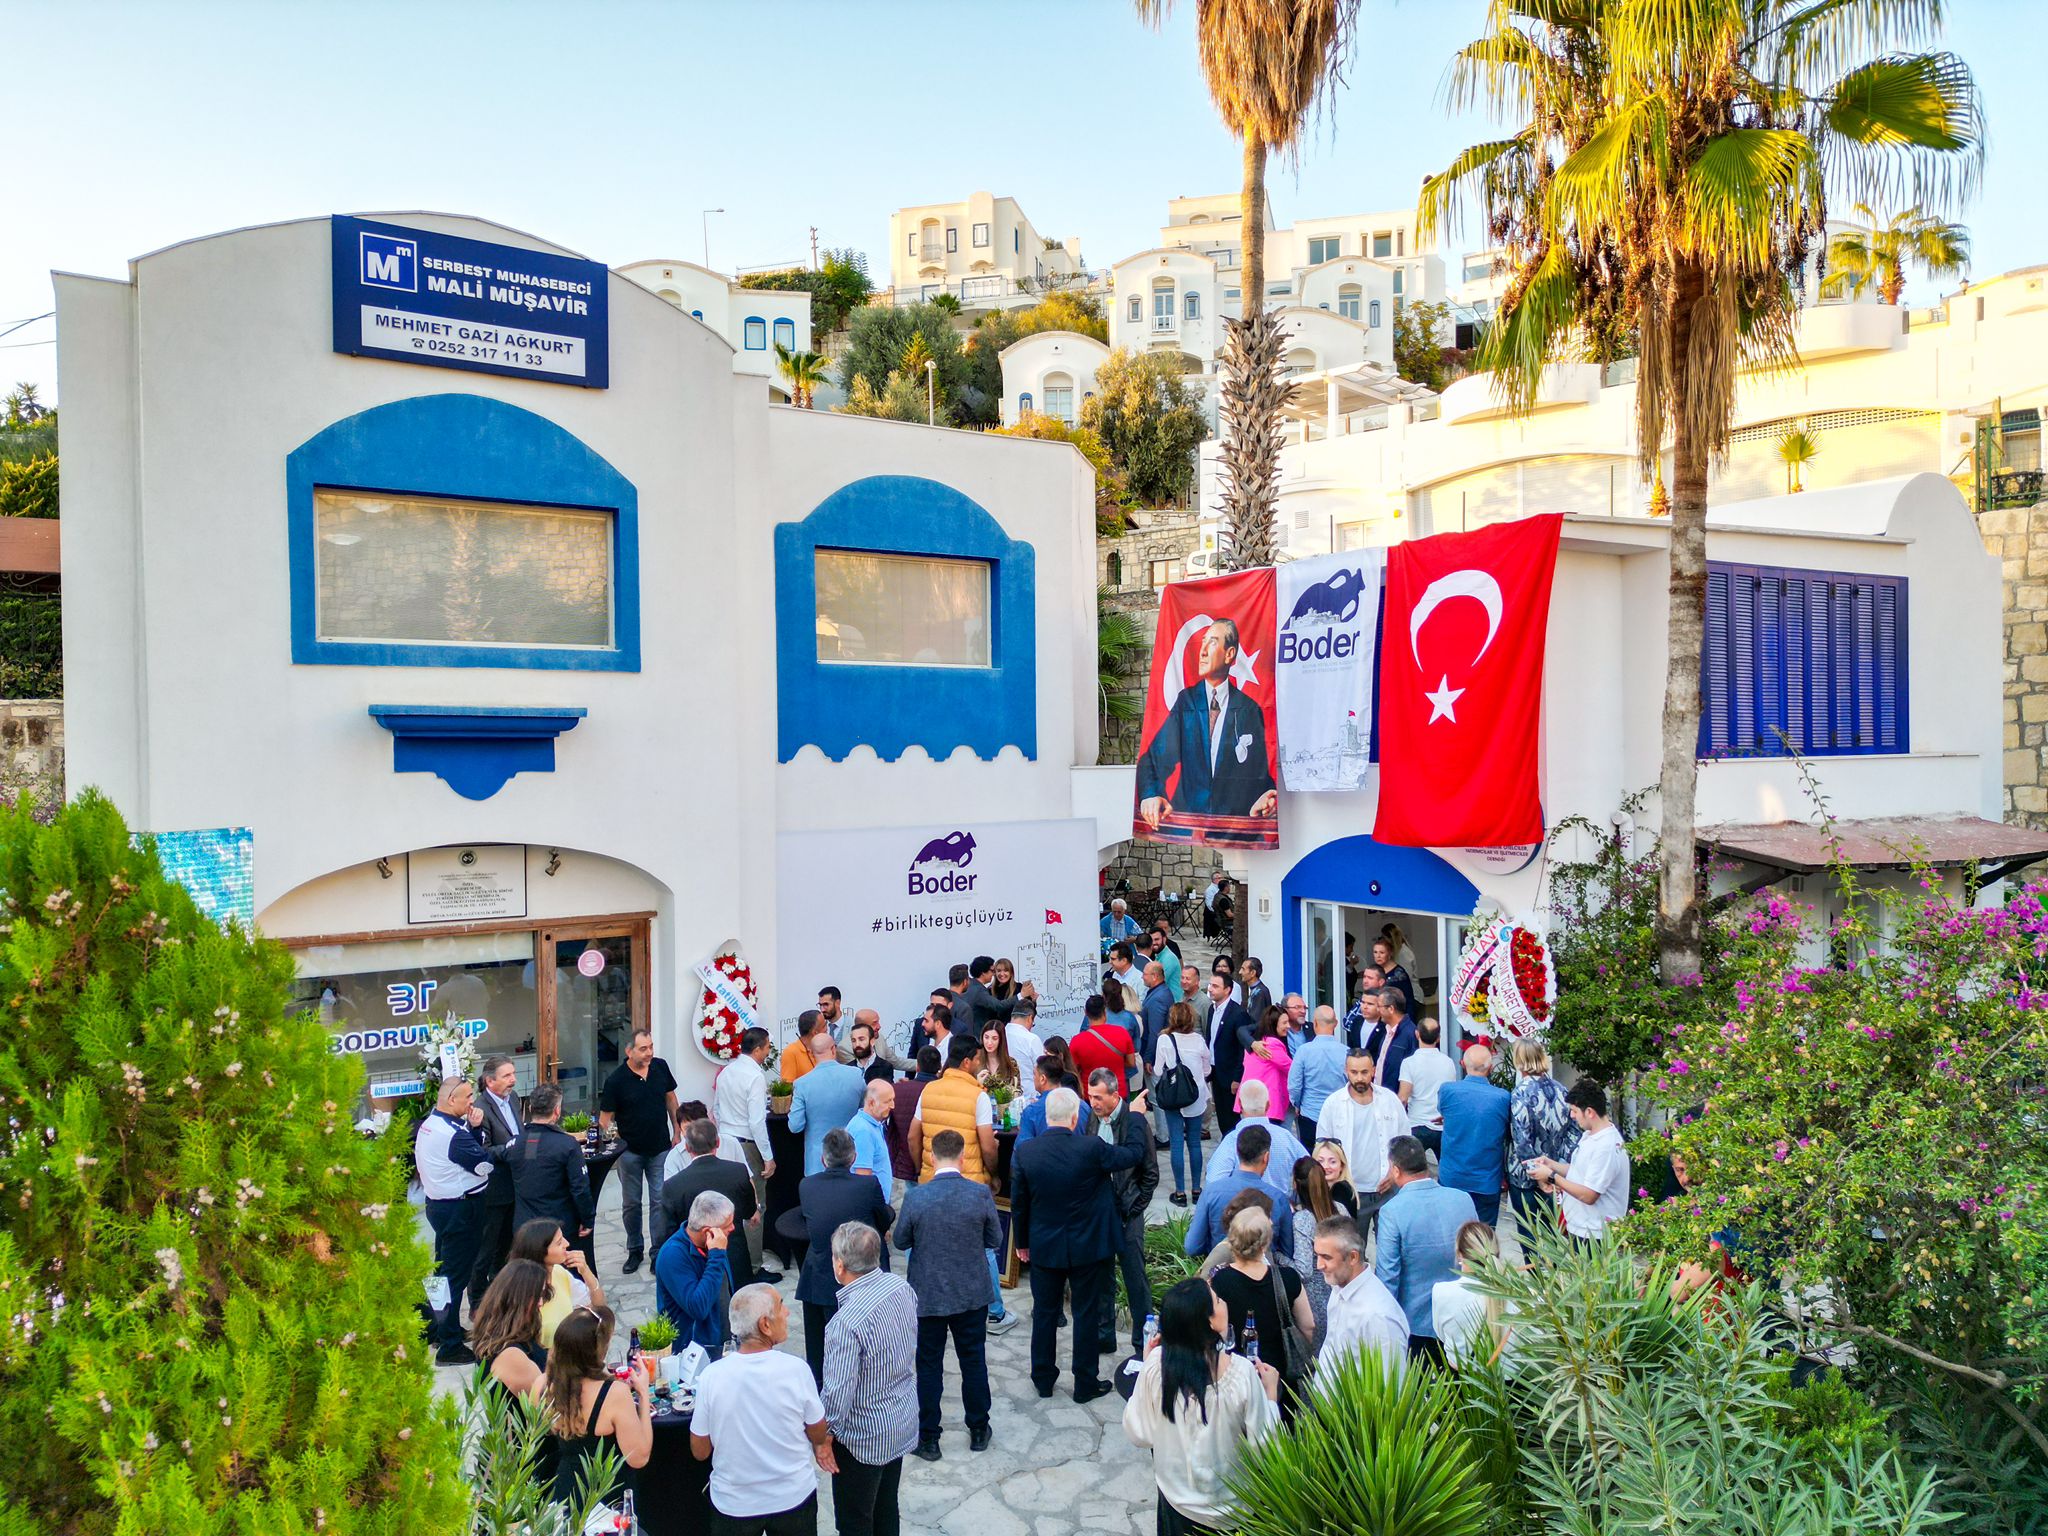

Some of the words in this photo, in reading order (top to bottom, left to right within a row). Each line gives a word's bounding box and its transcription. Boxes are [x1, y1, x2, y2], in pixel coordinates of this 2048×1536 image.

[422, 256, 492, 279] SERBEST
[496, 269, 592, 296] MUHASEBECİ
[427, 275, 483, 299] MALİ
[490, 285, 588, 316] MÜŞAVİR
[375, 314, 452, 337] MEHMET
[458, 326, 499, 345] GAZİ
[505, 332, 574, 355] AĞKURT
[428, 340, 465, 356] 0252
[471, 345, 498, 361] 317
[503, 351, 520, 364] 11
[525, 353, 543, 366] 33
[1278, 627, 1361, 663] Boder
[908, 870, 978, 895] Boder
[871, 907, 1014, 933] #birliktegüçlüyüz
